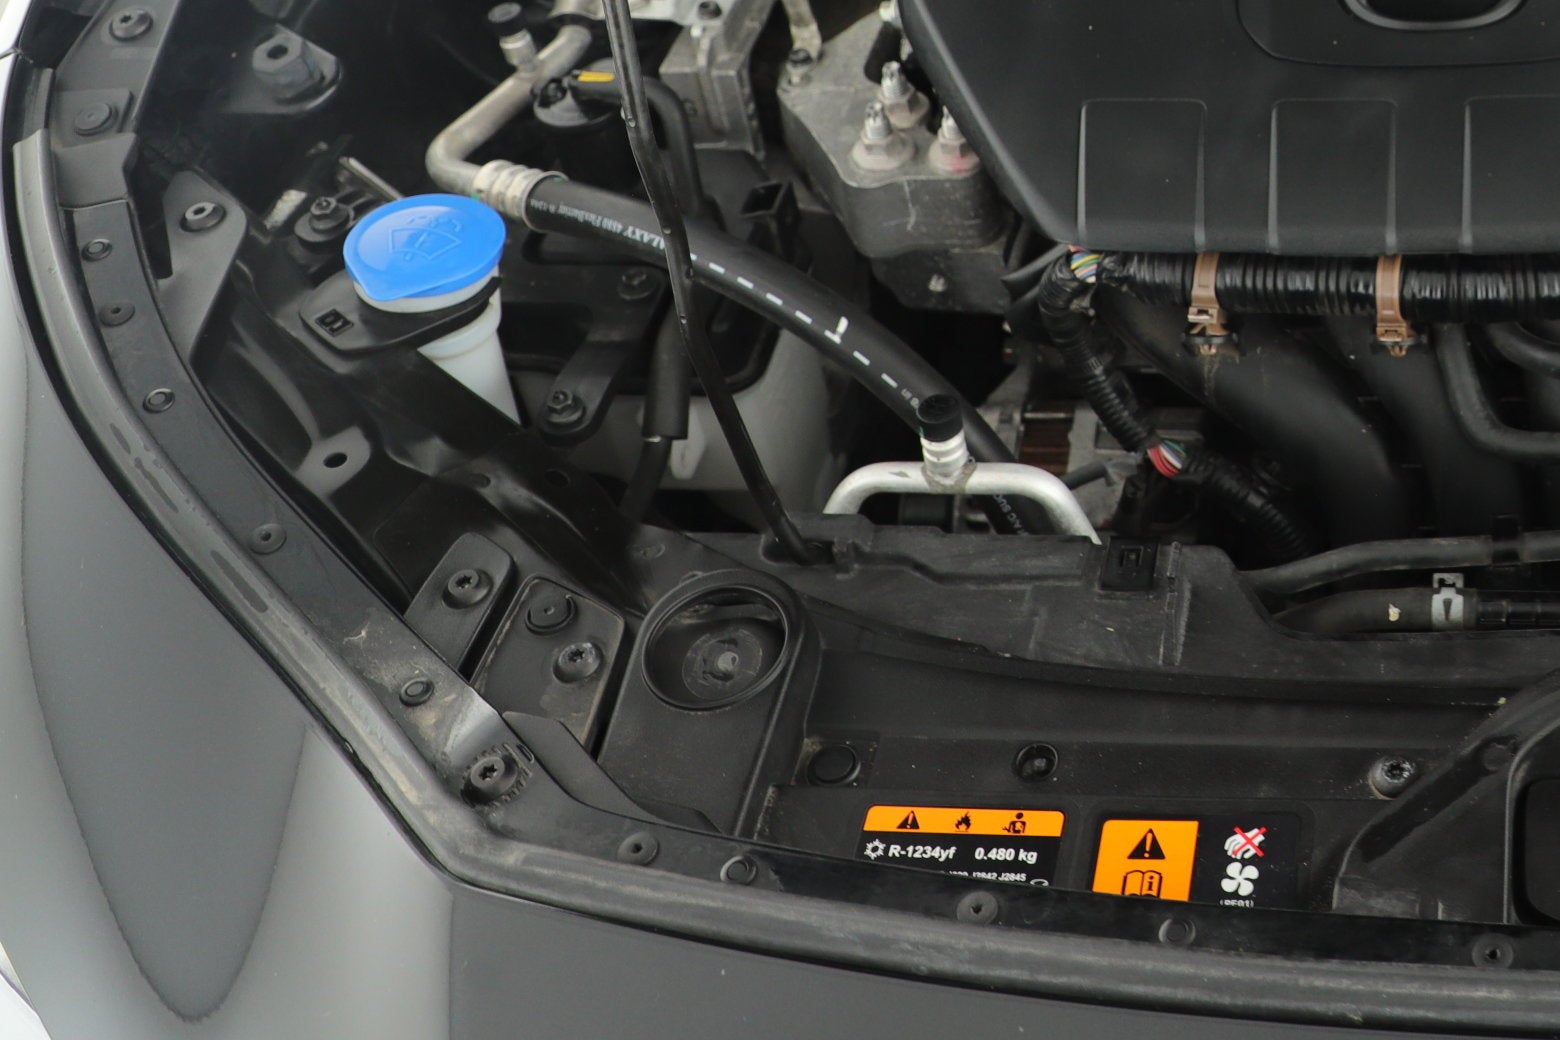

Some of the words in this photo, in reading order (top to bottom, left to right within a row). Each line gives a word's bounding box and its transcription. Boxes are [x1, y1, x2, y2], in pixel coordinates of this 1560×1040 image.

[622, 226, 667, 250] ALAXY
[887, 844, 957, 861] R-1234yf
[974, 847, 1016, 861] 0.480
[1018, 848, 1038, 865] kg
